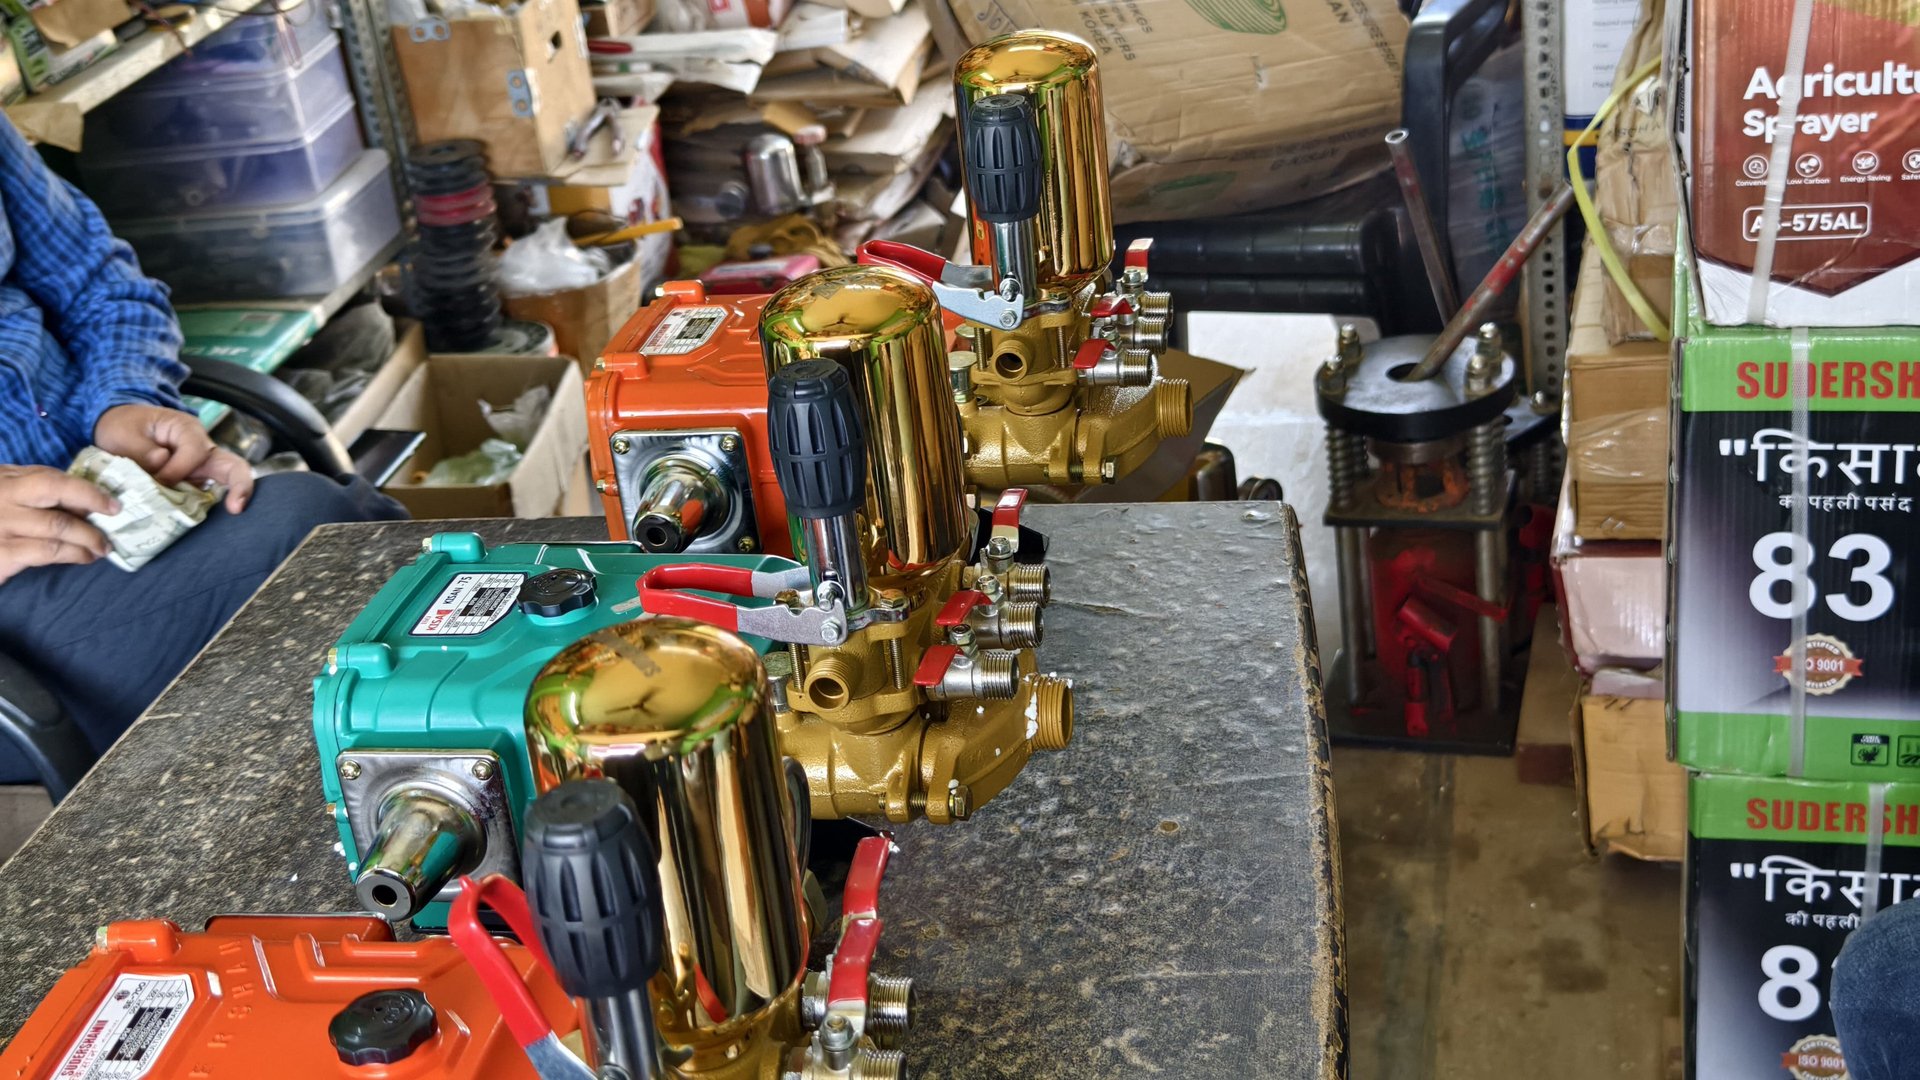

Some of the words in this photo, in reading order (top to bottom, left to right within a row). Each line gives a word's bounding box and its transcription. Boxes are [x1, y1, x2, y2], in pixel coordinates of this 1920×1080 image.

[1080, 11, 1112, 55] KOREA
[1803, 177, 1830, 185] Carbon
[1840, 175, 1866, 183] Energy
[1867, 173, 1891, 182] Saving
[1750, 212, 1863, 233] A-575AL
[1808, 492, 1860, 512] पहली
[1864, 493, 1912, 512] पसंद
[1749, 532, 1895, 622] 83
[1816, 659, 1844, 672] 9001
[1785, 910, 1808, 927] की
[1758, 945, 1838, 1021] 8
[1798, 1056, 1818, 1067] ISO
